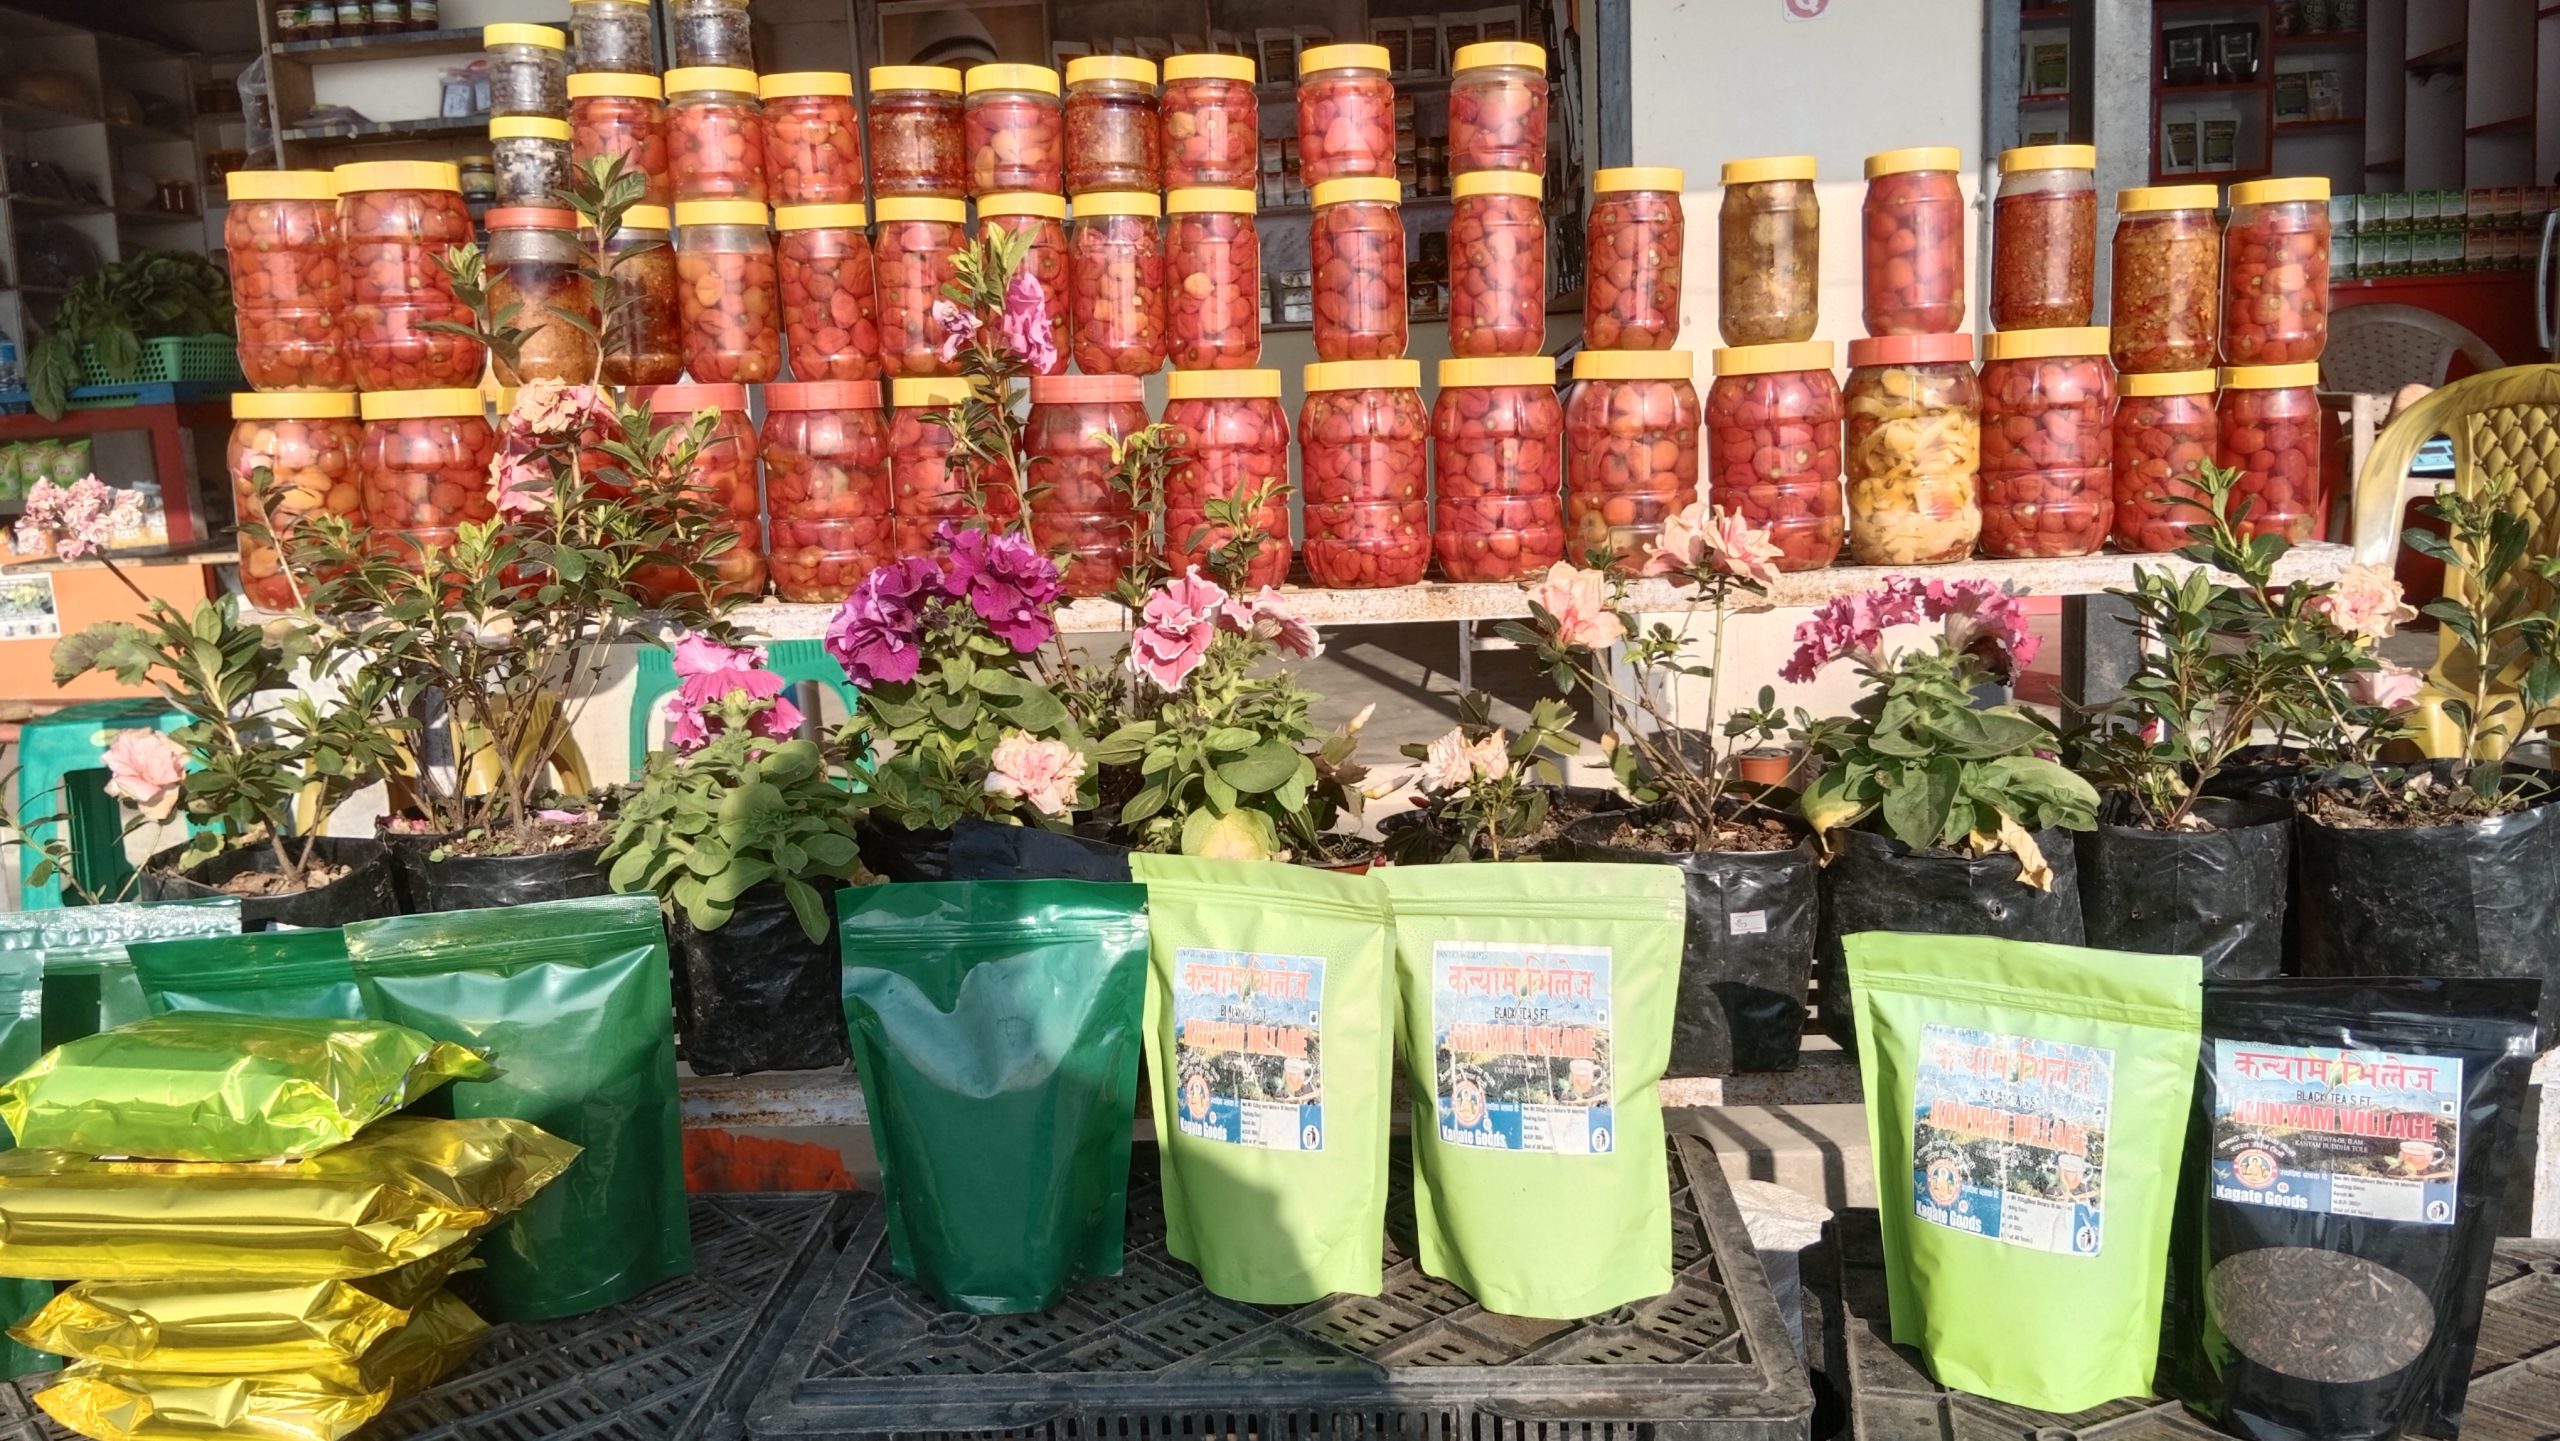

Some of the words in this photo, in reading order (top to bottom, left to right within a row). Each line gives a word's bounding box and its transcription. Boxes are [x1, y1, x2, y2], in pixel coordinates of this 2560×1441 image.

[2234, 1051, 2334, 1086] कन्याम
[2340, 1051, 2440, 1095] भिलेज
[2296, 1090, 2325, 1103] BLACK
[2330, 1093, 2346, 1105] TEA
[2235, 1100, 2334, 1133] KANYAM
[2340, 1107, 2438, 1142] VILLAGE
[1474, 1128, 1506, 1148] Goods
[2216, 1184, 2262, 1203] Kagate
[2264, 1190, 2308, 1209] Goods
[1915, 1199, 1948, 1224] Kagate
[1949, 1209, 1982, 1233] Goods
